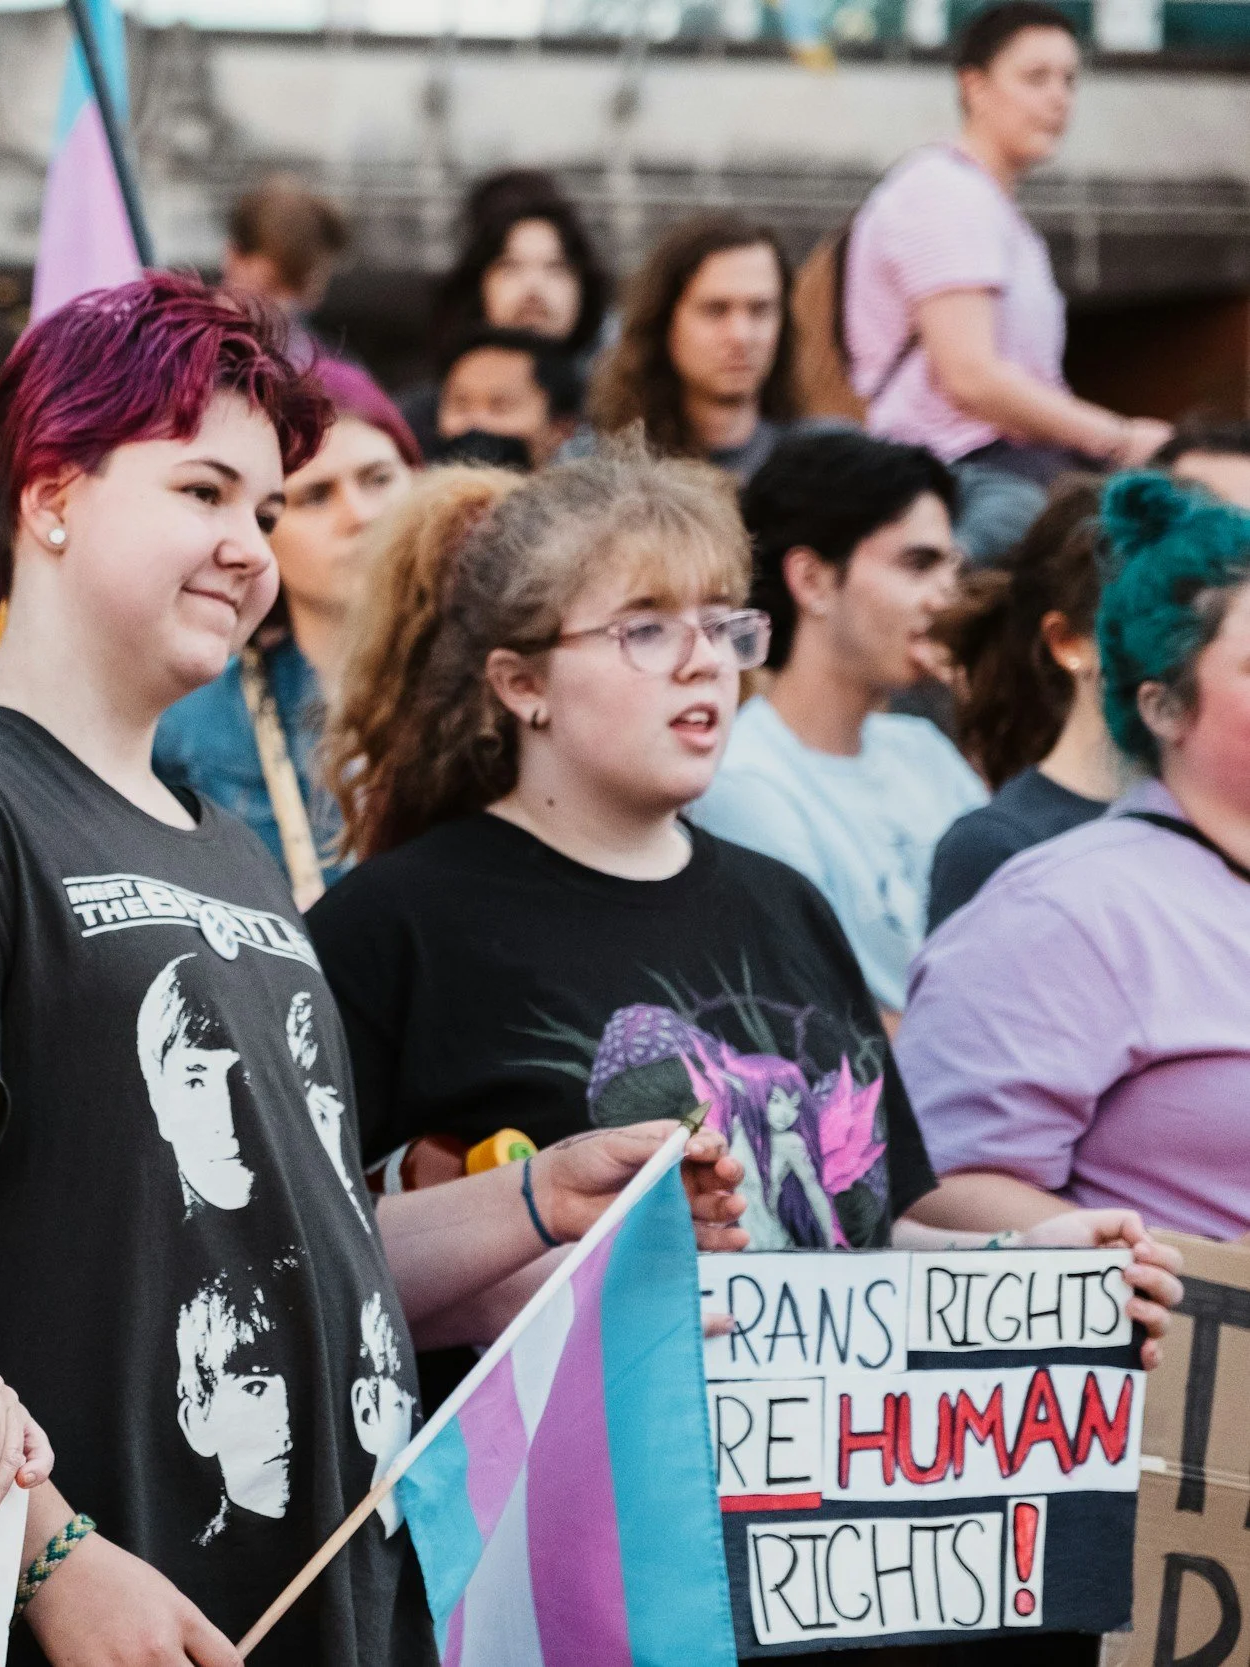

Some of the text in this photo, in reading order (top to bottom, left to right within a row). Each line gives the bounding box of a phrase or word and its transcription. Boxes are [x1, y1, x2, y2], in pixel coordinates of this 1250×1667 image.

[65, 880, 135, 905] MEET
[72, 897, 151, 928] THE
[701, 1267, 1124, 1370] RANS RIGHTS
[715, 1366, 1134, 1490] RE HUMAN
